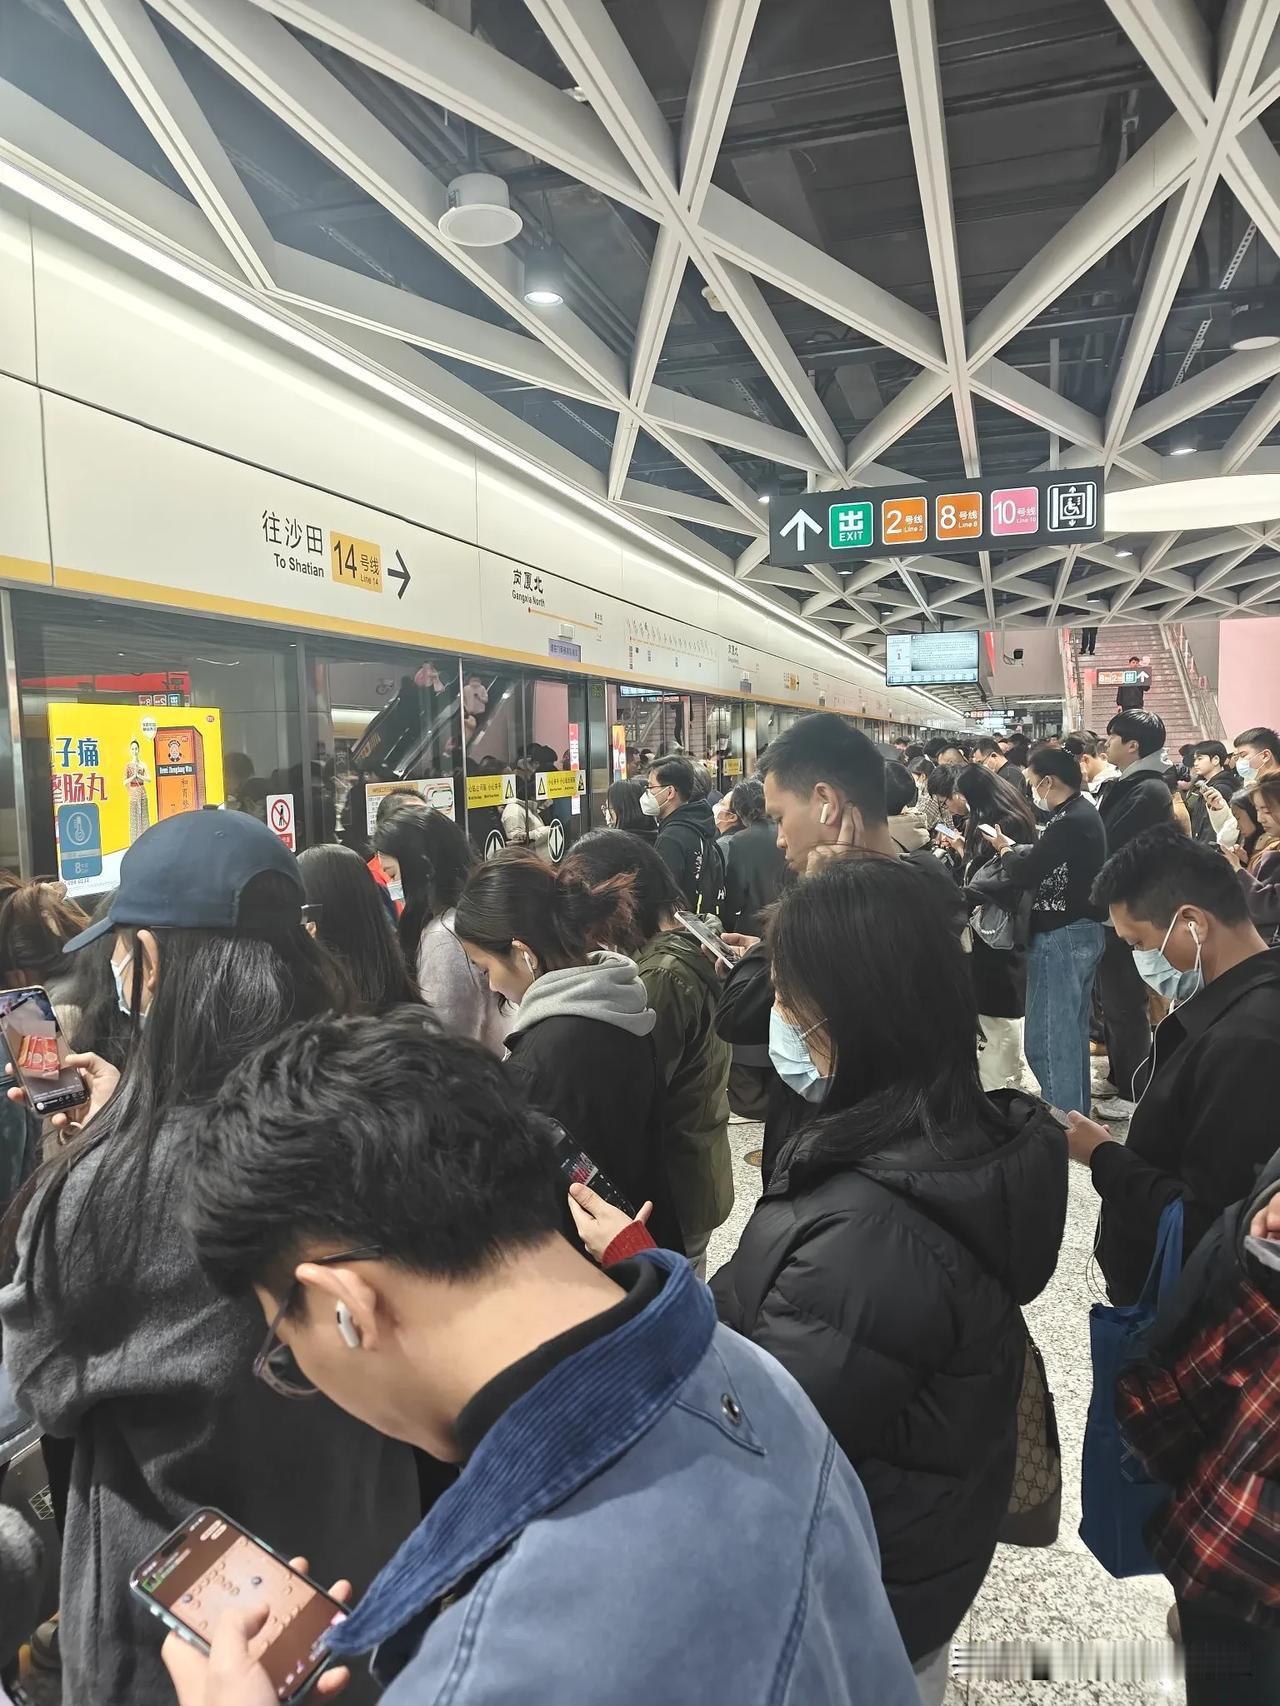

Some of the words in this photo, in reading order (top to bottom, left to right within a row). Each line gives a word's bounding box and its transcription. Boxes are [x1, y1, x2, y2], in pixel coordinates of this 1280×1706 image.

[838, 510, 864, 532] 出
[958, 521, 972, 529] Line
[1016, 516, 1028, 524] Line
[261, 509, 323, 556] 往沙田
[904, 525, 917, 533] Line
[839, 530, 864, 542] EXIT
[273, 553, 286, 569] To
[289, 556, 325, 578] Shatian
[360, 574, 371, 585] Line
[51, 737, 99, 768] 子痛
